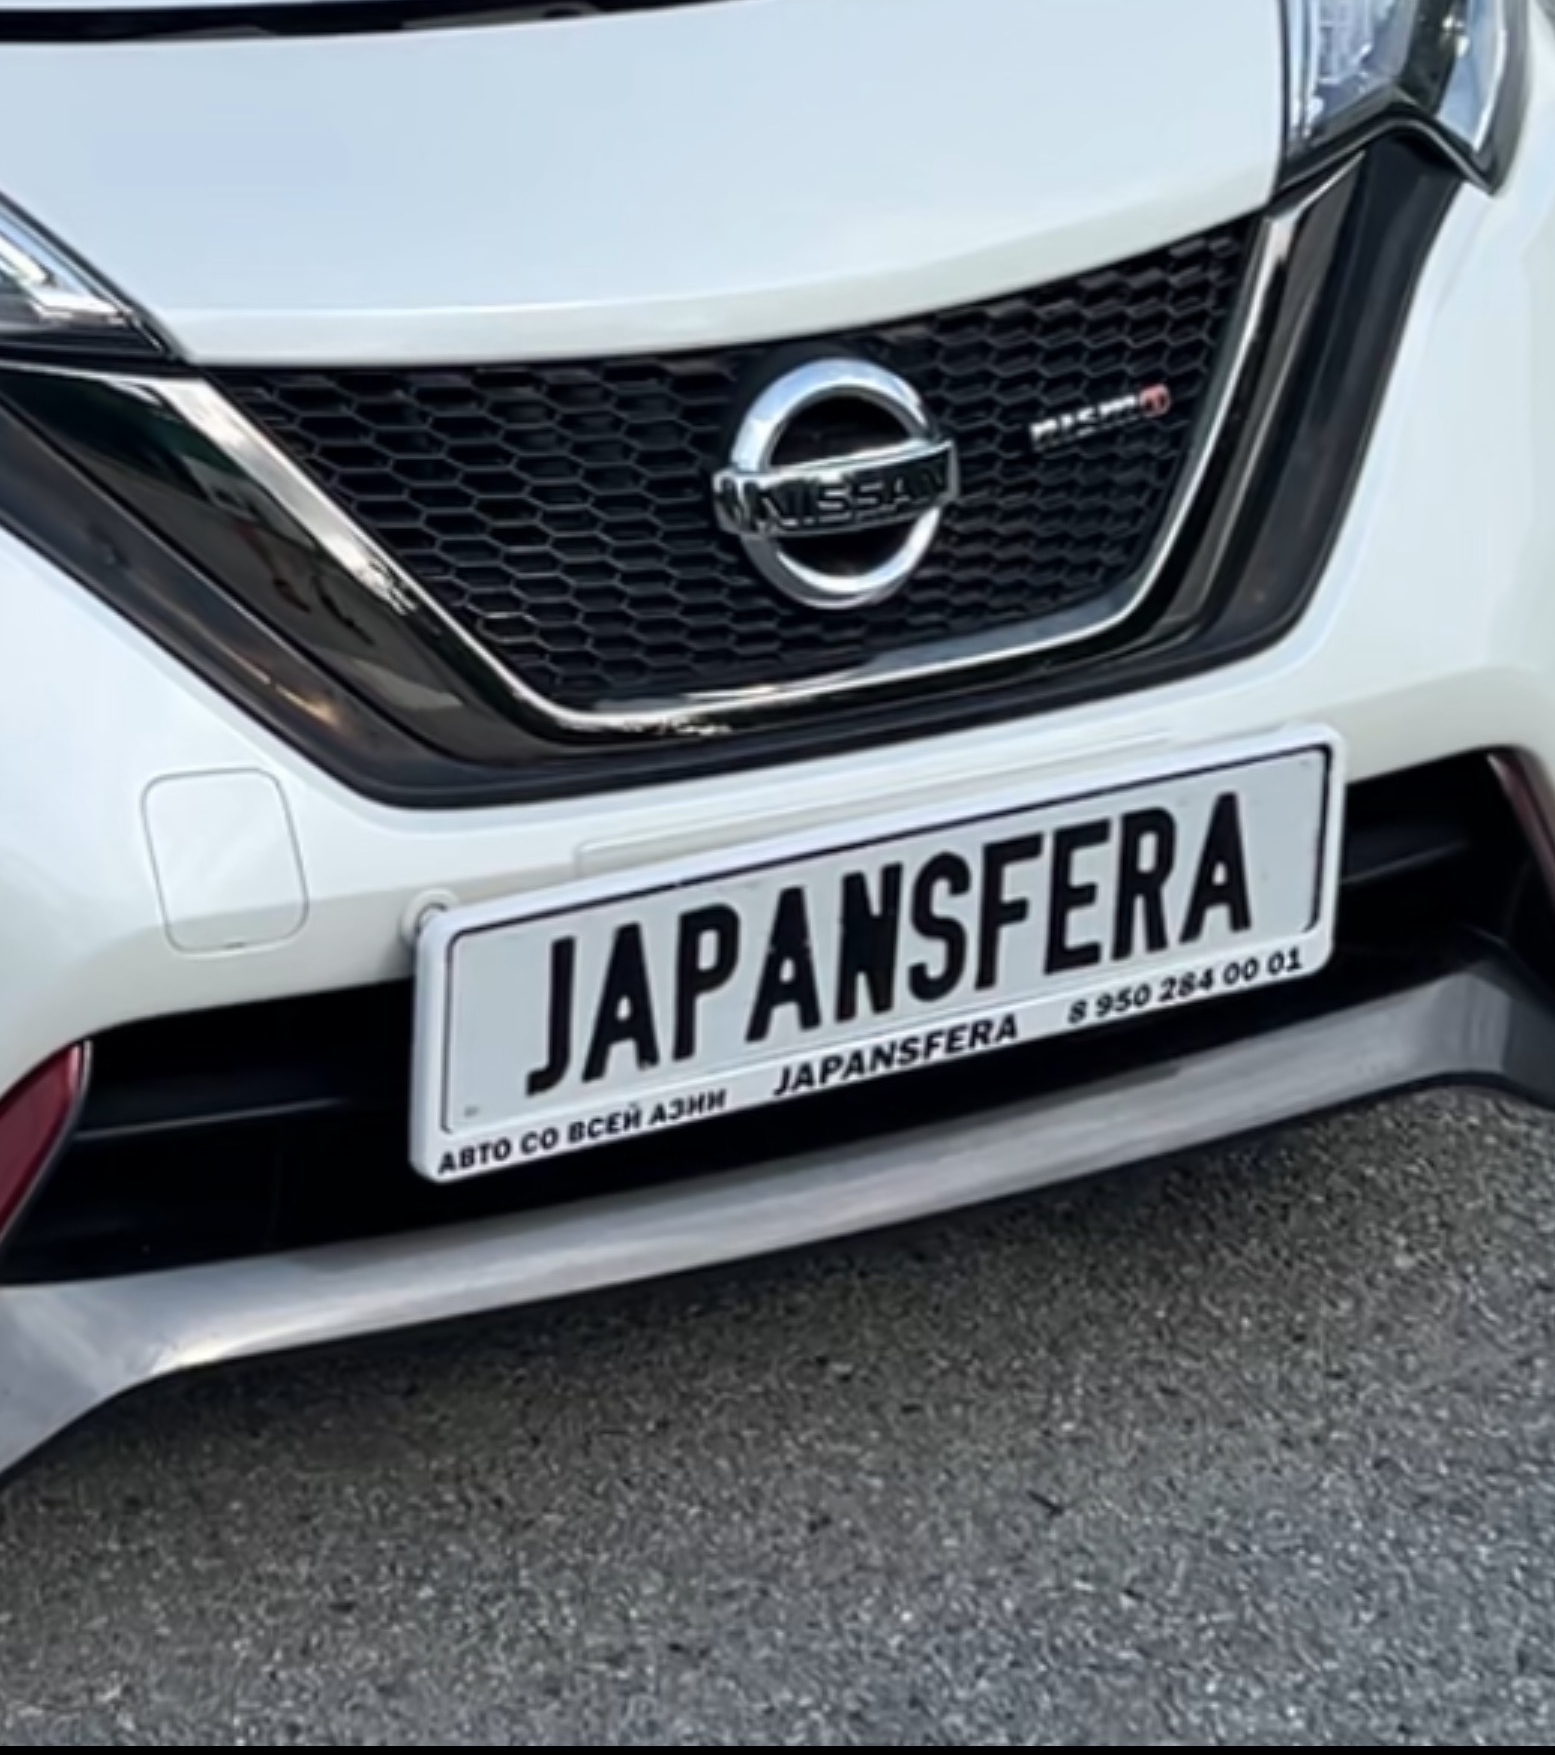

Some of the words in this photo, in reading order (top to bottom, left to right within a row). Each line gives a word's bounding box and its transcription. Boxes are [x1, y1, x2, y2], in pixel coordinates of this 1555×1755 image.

[746, 450, 954, 531] NISSAN
[525, 791, 1252, 1097] JAPANSFERA
[1066, 1001, 1088, 1024] 8
[1094, 985, 1151, 1018] 950
[1158, 972, 1215, 1003] 284
[1223, 960, 1260, 987] 00
[1266, 948, 1304, 976] 01
[773, 1013, 1019, 1098] JAPANSFERA
[437, 1138, 512, 1177] АВТО
[520, 1126, 560, 1155] СО
[567, 1101, 643, 1144] ВСЕЙ
[648, 1087, 728, 1126] АЗИИ
